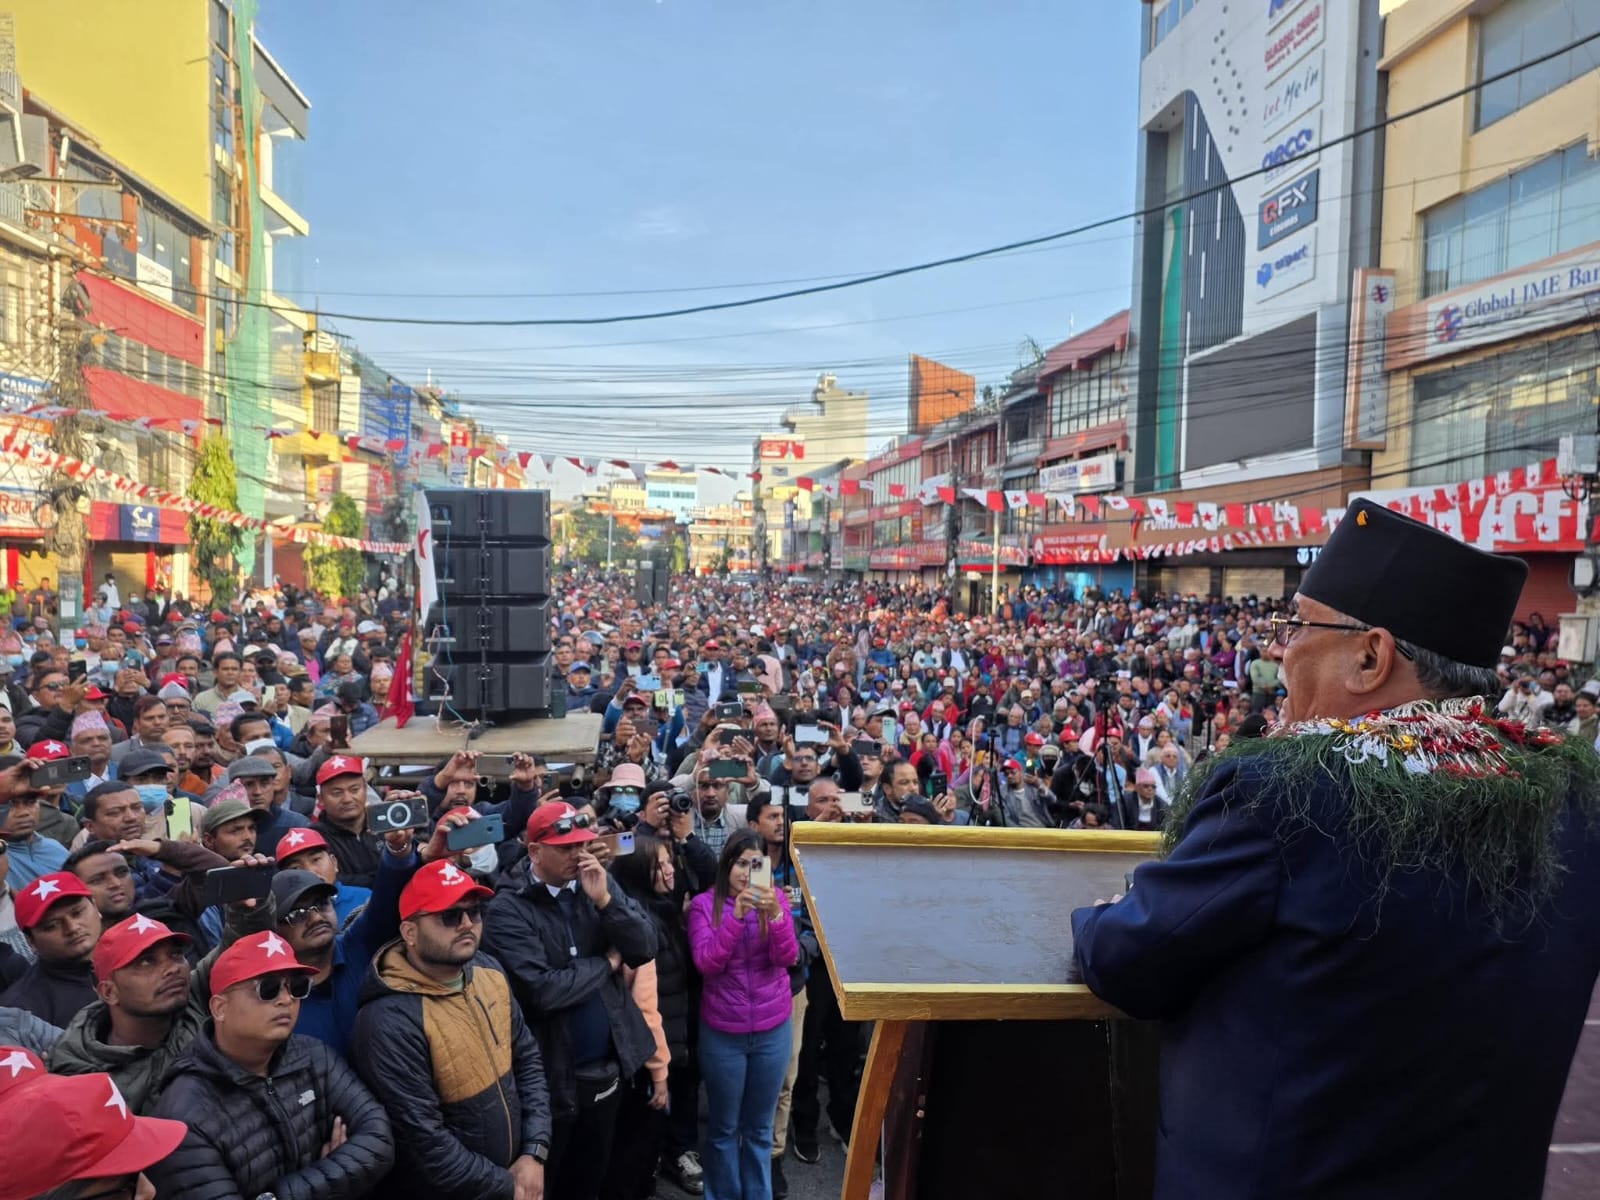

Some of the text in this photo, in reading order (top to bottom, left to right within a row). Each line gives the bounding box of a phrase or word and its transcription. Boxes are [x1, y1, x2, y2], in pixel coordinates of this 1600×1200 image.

[1263, 180, 1309, 225] QFX
[1464, 288, 1515, 318] Global
[1522, 273, 1561, 302] IME
